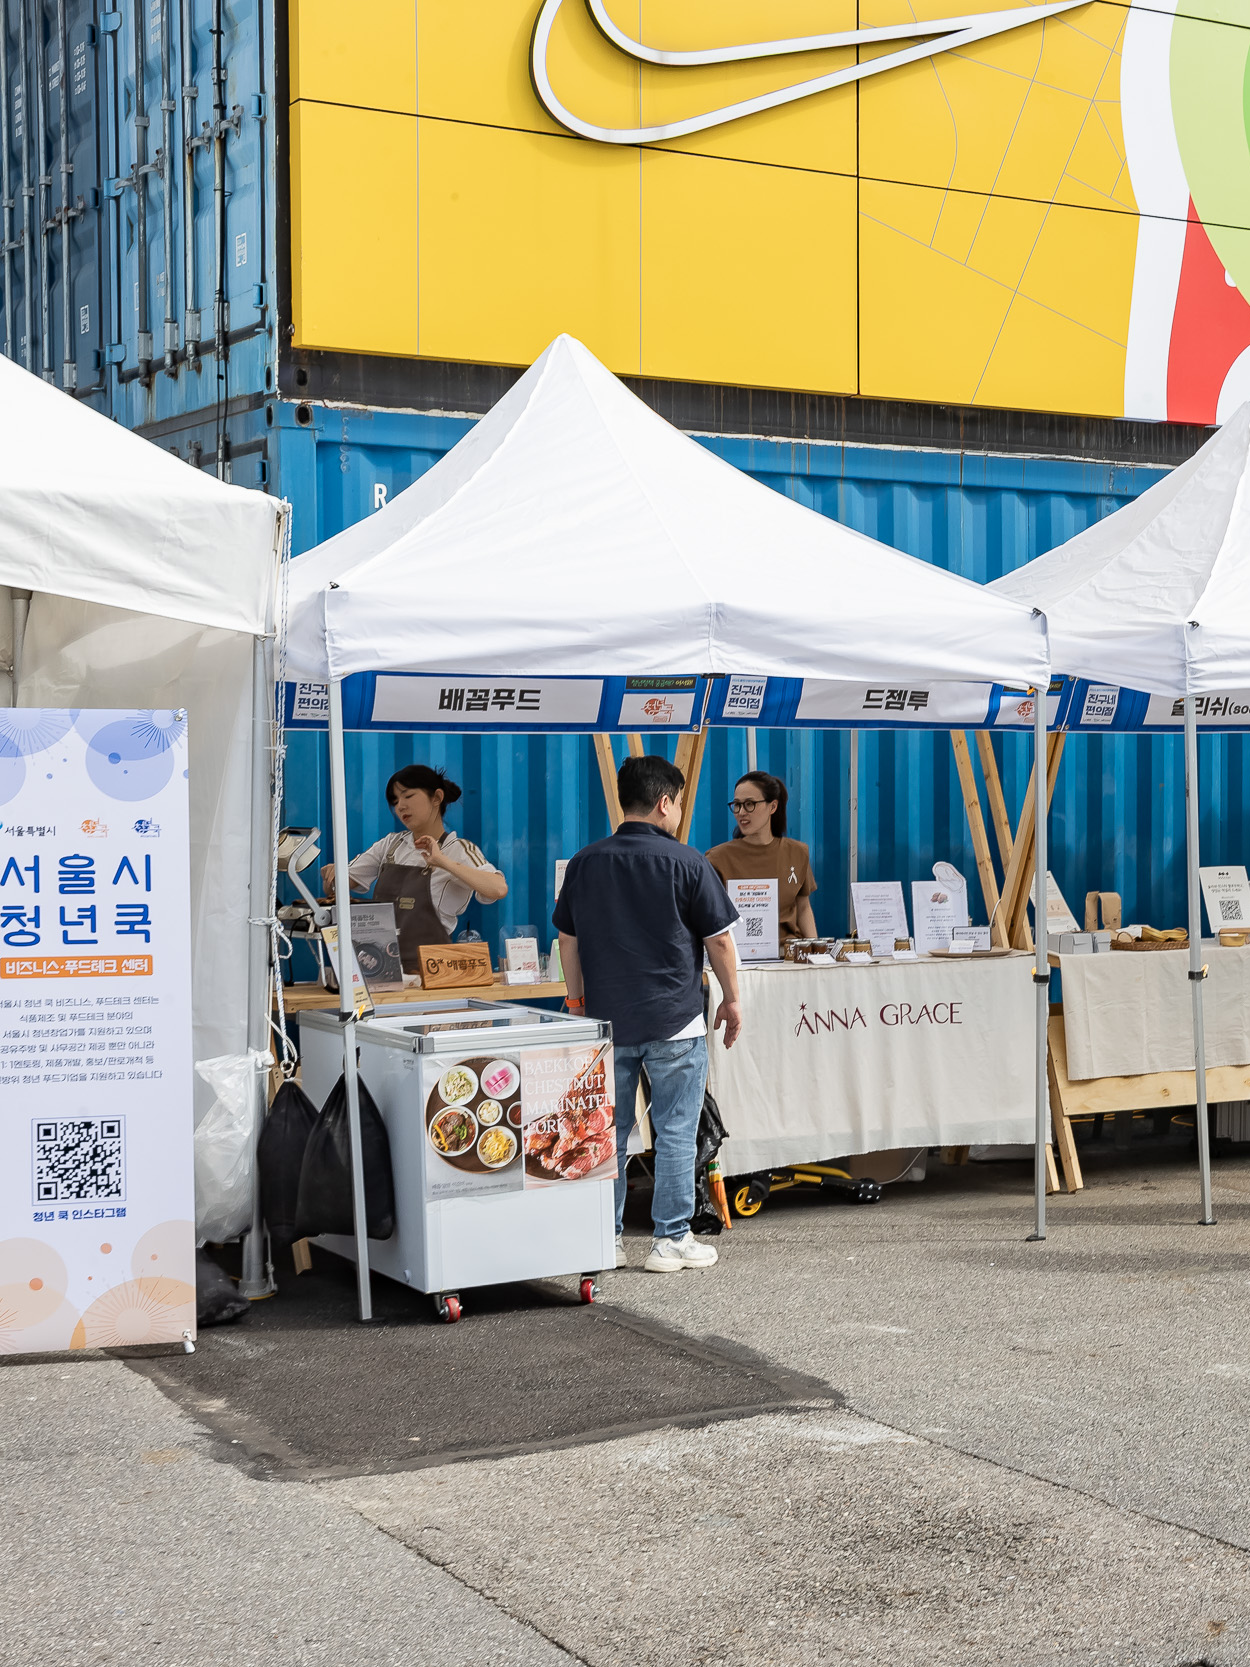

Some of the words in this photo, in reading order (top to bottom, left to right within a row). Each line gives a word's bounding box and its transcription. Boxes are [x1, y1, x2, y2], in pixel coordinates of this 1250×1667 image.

[299, 683, 328, 695] 진구
[731, 684, 763, 696] 진구네
[438, 688, 541, 711] 배꼽푸드
[728, 697, 760, 709] 편의점
[862, 689, 929, 711] 드젬루
[1088, 693, 1117, 705] 진구네
[1085, 705, 1115, 716] 편의점
[5, 825, 56, 837] 서울특별시
[0, 854, 151, 894] 서울시
[0, 904, 151, 946] 청년쿡
[5, 959, 118, 975] 비즈니스·푸드테크
[121, 958, 149, 974] 센터
[447, 958, 487, 970] 배꼽푸드
[24, 999, 42, 1008] 청년
[95, 997, 131, 1006] 푸드테크
[133, 996, 159, 1005] 센터는
[20, 1013, 55, 1023] 식품제조
[69, 1012, 104, 1021] 푸드테크
[107, 1011, 133, 1020] 분야의
[879, 1002, 963, 1025] GRACE
[3, 1029, 29, 1039] 서울시
[32, 1028, 86, 1037] 청년창업가를
[88, 1027, 124, 1036] 지원하고
[126, 1026, 152, 1035] 있으며
[0, 1045, 37, 1054] 공유주방
[50, 1043, 86, 1052] 사무공간
[88, 1042, 106, 1051] 제공
[128, 1040, 154, 1050] 아니라
[22, 1074, 40, 1084] 청년
[43, 1073, 87, 1083] 푸드기업을
[90, 1071, 125, 1081] 지원하고
[127, 1070, 163, 1080] 있습니다
[524, 1074, 605, 1095] CHESTNUT
[526, 1092, 613, 1115] MARINATED
[526, 1117, 567, 1135] PORK
[33, 1211, 55, 1222] 청년
[58, 1210, 69, 1220] 쿡
[72, 1207, 127, 1220] 인스타그램
